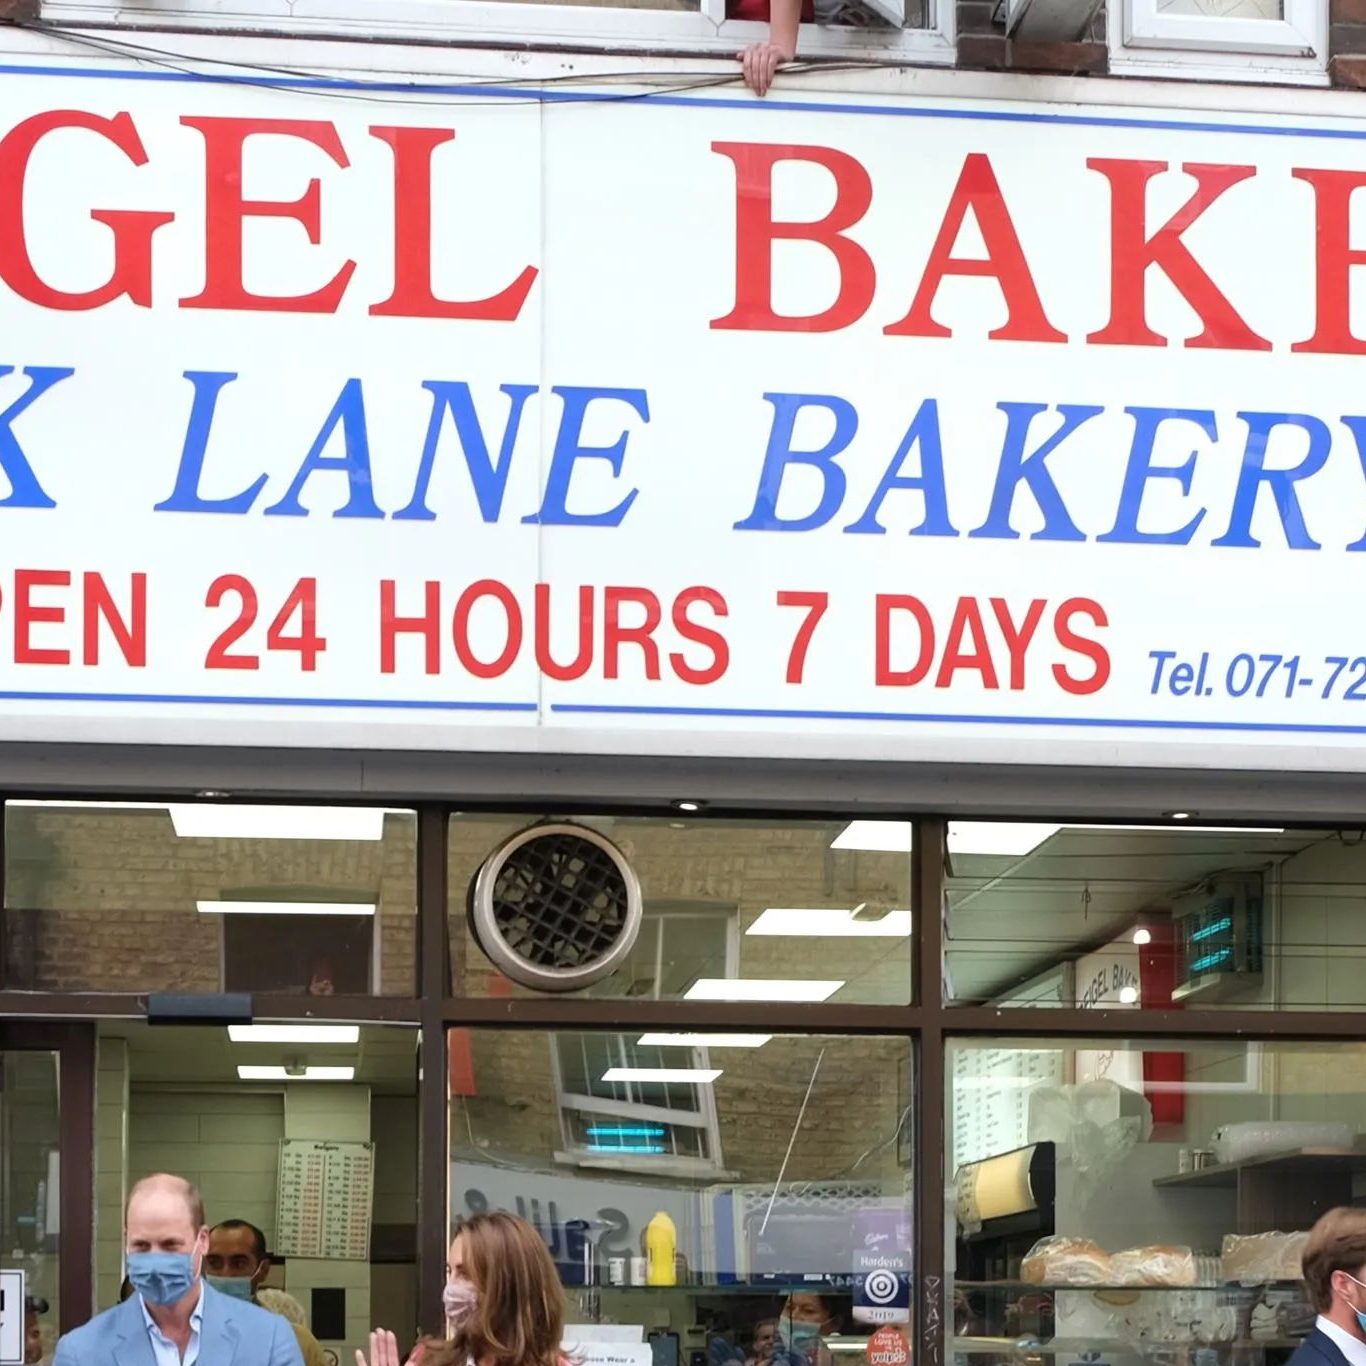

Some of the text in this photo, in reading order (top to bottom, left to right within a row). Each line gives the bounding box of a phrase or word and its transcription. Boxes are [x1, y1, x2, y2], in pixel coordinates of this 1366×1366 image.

[154, 371, 651, 526] LANE
[205, 574, 327, 672] 24
[380, 579, 730, 686] HOURS
[777, 590, 828, 685] 7
[875, 593, 1111, 696] DAYS
[860, 1255, 904, 1268] Harden's
[867, 1308, 896, 1321] 2019
